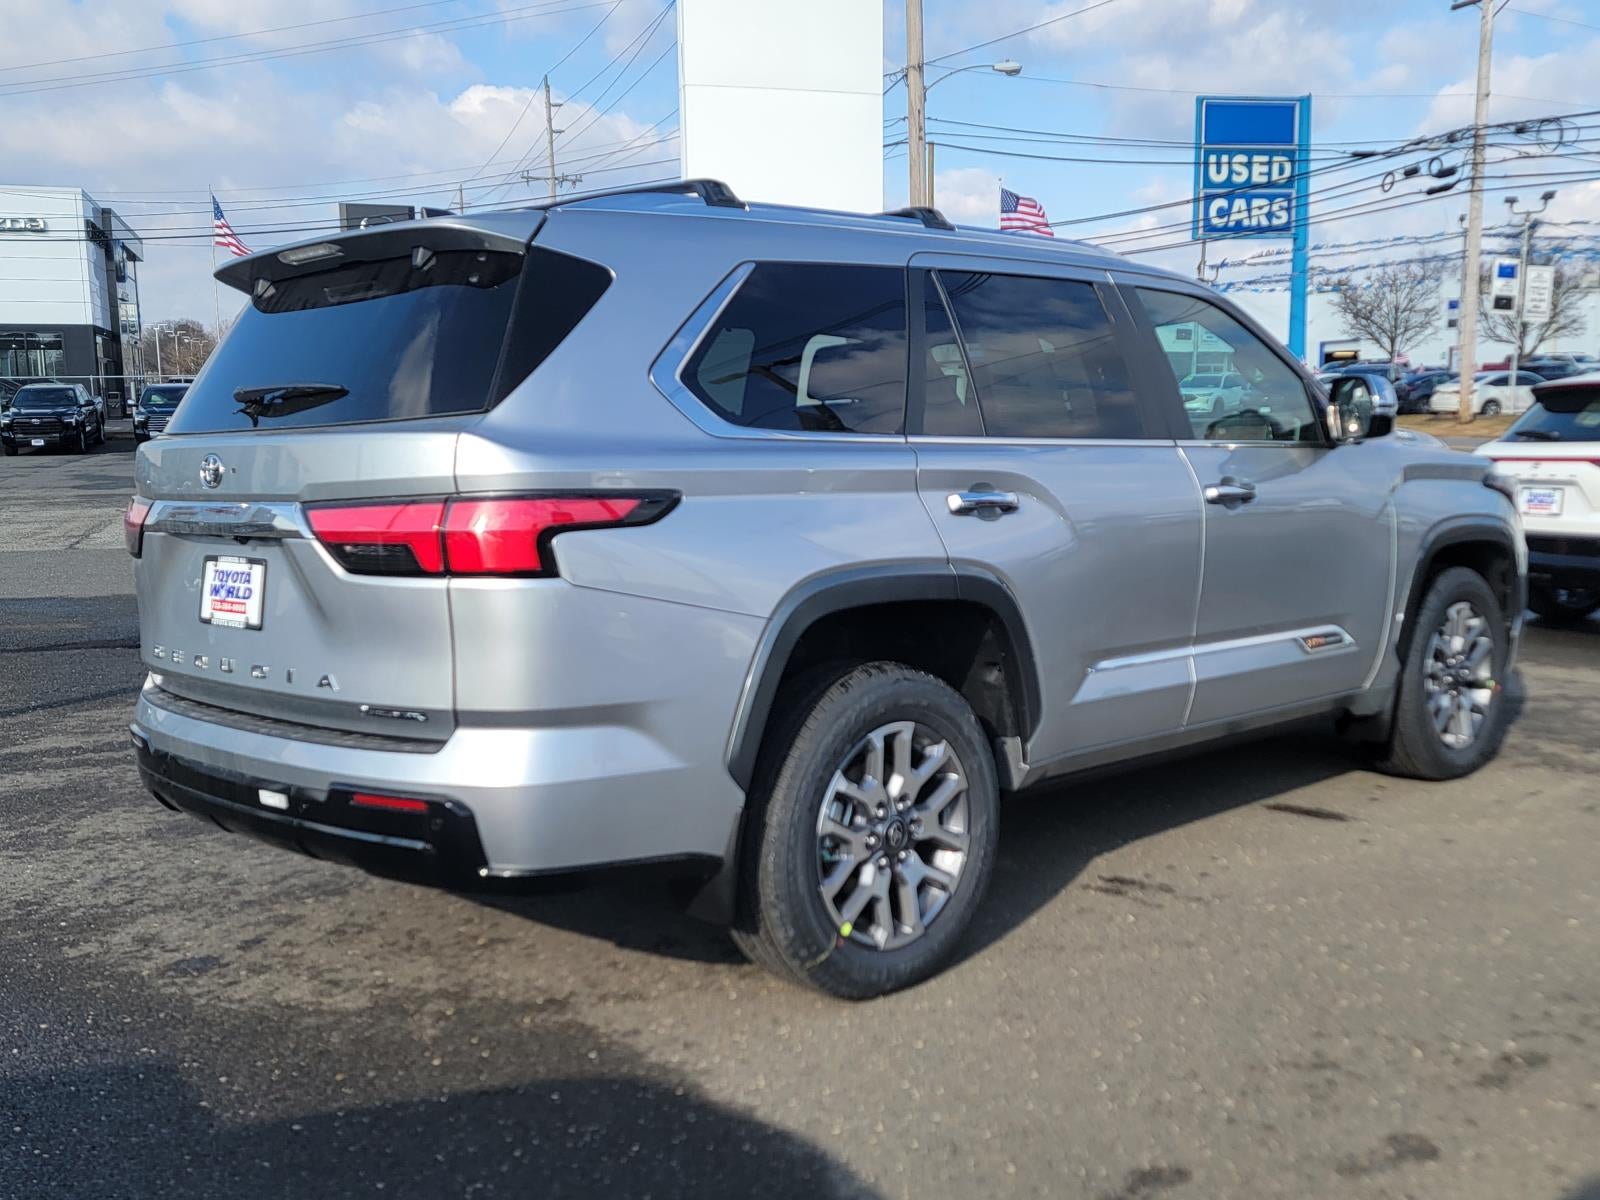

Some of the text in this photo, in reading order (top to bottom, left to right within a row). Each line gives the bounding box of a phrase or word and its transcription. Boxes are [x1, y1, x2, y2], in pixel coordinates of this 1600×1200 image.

[1208, 153, 1292, 184] USED
[1209, 197, 1289, 228] CARS
[210, 583, 253, 600] WORLD
[213, 569, 252, 584] TOYOTA
[152, 644, 340, 692] SEQUOIA
